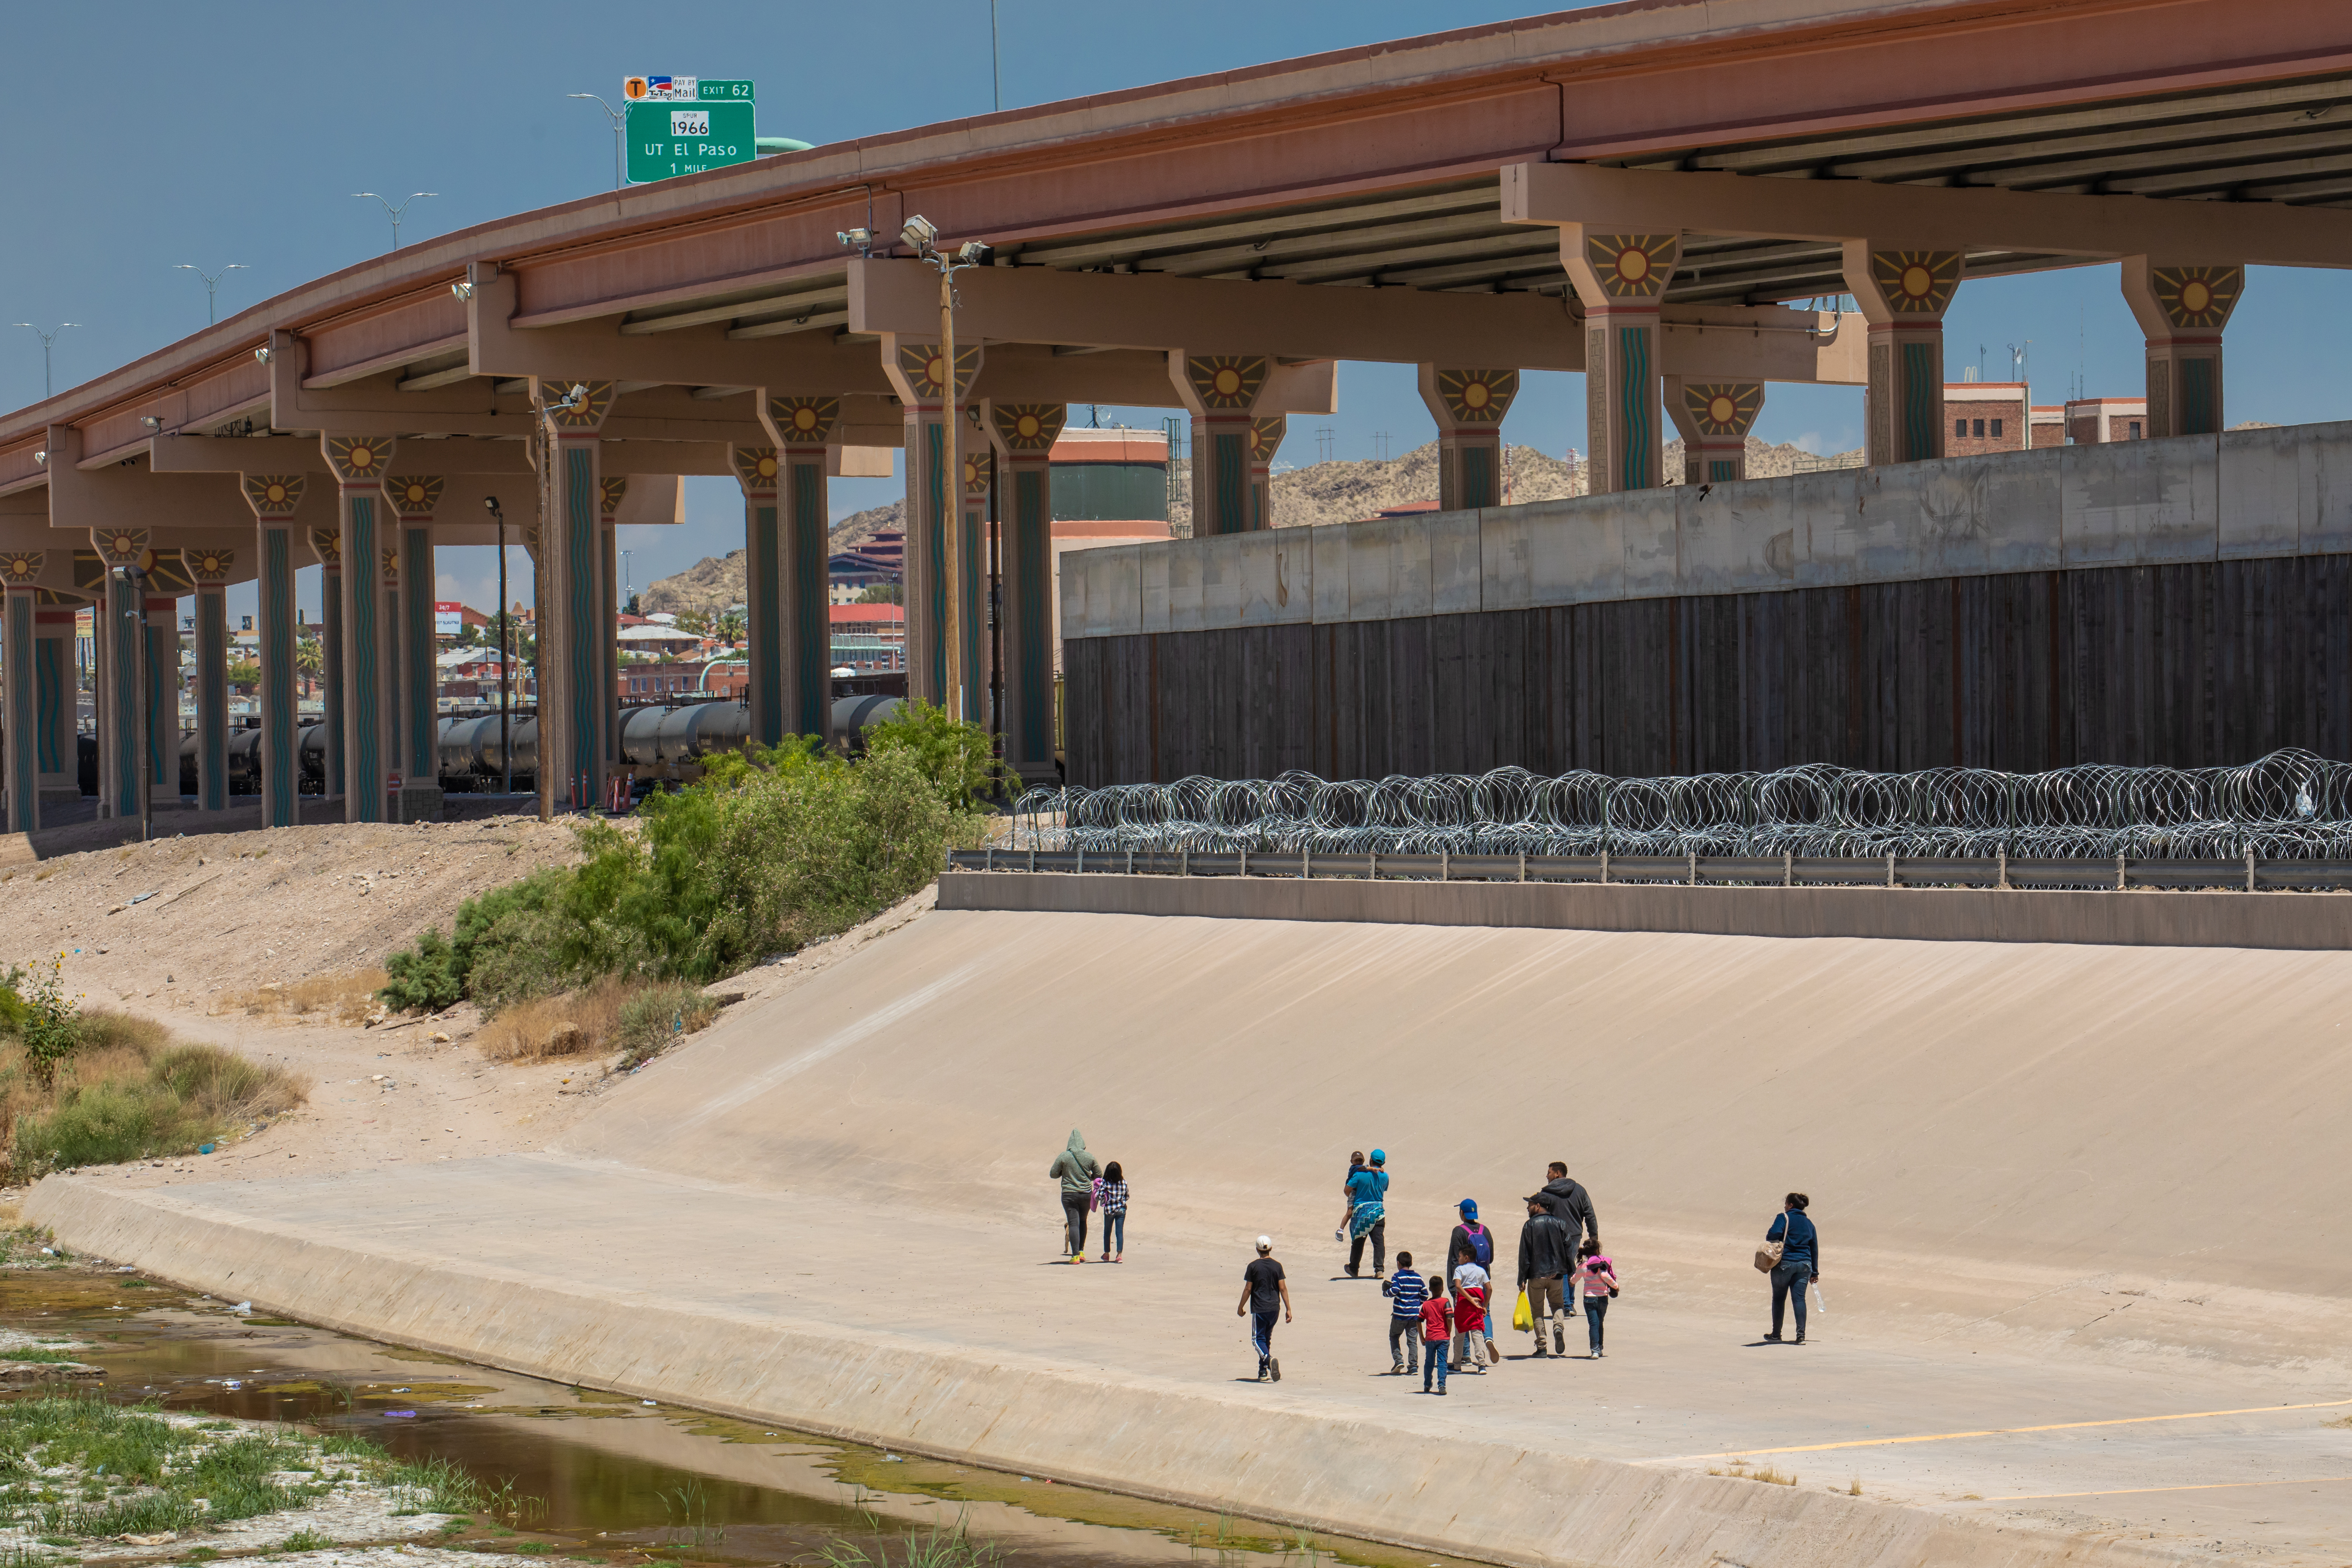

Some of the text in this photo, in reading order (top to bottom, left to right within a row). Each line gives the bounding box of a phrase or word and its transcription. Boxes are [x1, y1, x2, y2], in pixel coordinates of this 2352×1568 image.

[630, 81, 641, 96] T
[675, 88, 696, 97] Mail
[703, 84, 749, 96] EXIT 62
[672, 121, 708, 134] 1966
[645, 143, 737, 156] UT El Paso
[670, 163, 707, 174] 1 MILE
